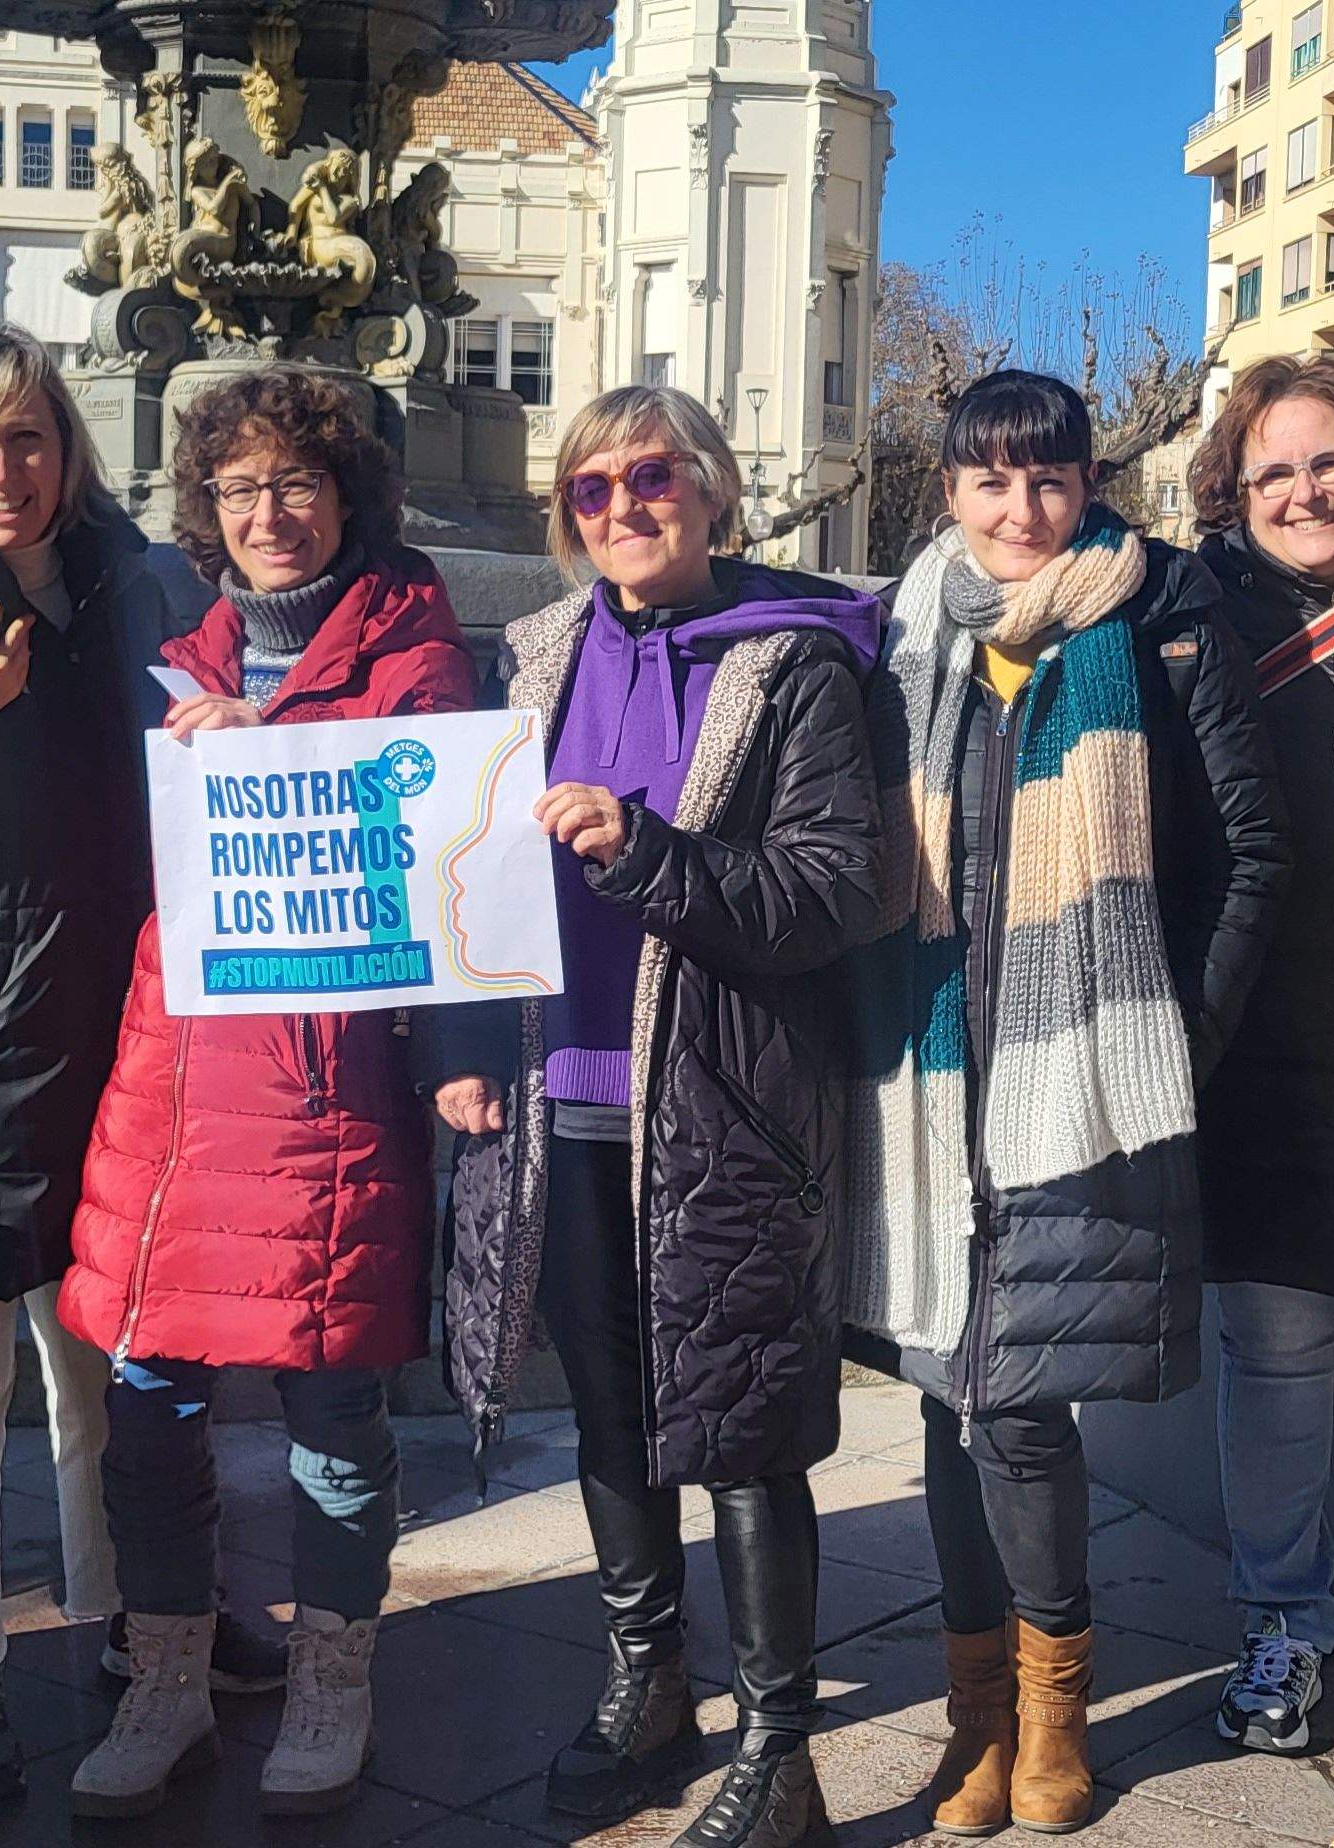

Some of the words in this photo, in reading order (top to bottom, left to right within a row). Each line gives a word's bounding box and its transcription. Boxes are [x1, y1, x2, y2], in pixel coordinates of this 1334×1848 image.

[385, 742, 425, 759] METGES
[205, 766, 385, 820] NOSOTRAS
[383, 776, 401, 794] DEL
[209, 823, 416, 878] ROMPEMOS
[213, 889, 276, 936] LOS
[283, 883, 402, 936] MITOS
[208, 944, 426, 989] #STOPMUTILACIÓN
